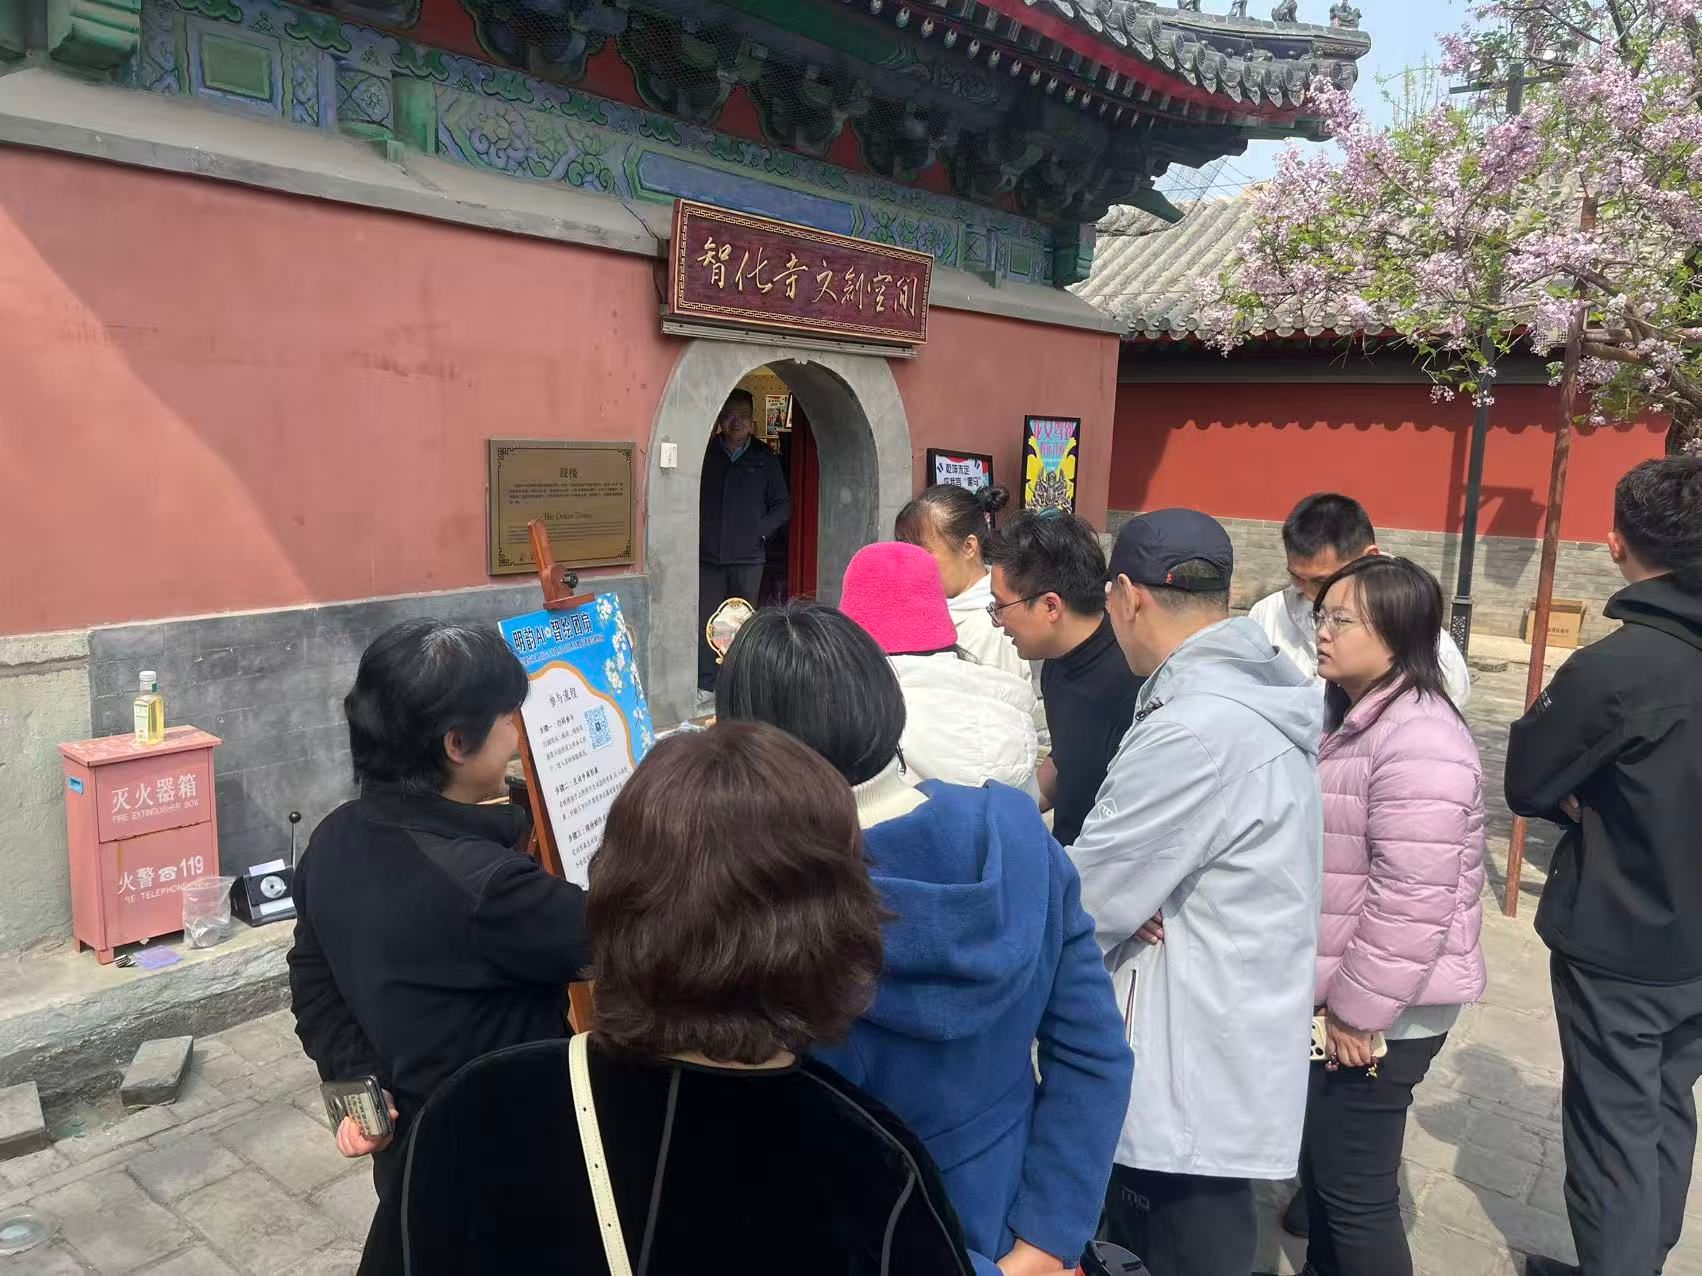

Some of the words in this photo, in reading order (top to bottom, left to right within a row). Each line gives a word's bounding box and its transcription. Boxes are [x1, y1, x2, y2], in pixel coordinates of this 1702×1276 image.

[560, 466, 578, 479] 鼓楼
[555, 512, 574, 521] Drum
[550, 612, 593, 642] 智绘团扇
[549, 688, 578, 708] 参与流程
[111, 773, 197, 813] 灭火器箱
[112, 814, 130, 824] FIRE
[132, 802, 181, 820] EXTINGUISHER
[184, 799, 200, 809] BOX
[117, 866, 155, 895] 火警
[179, 855, 204, 878] 119
